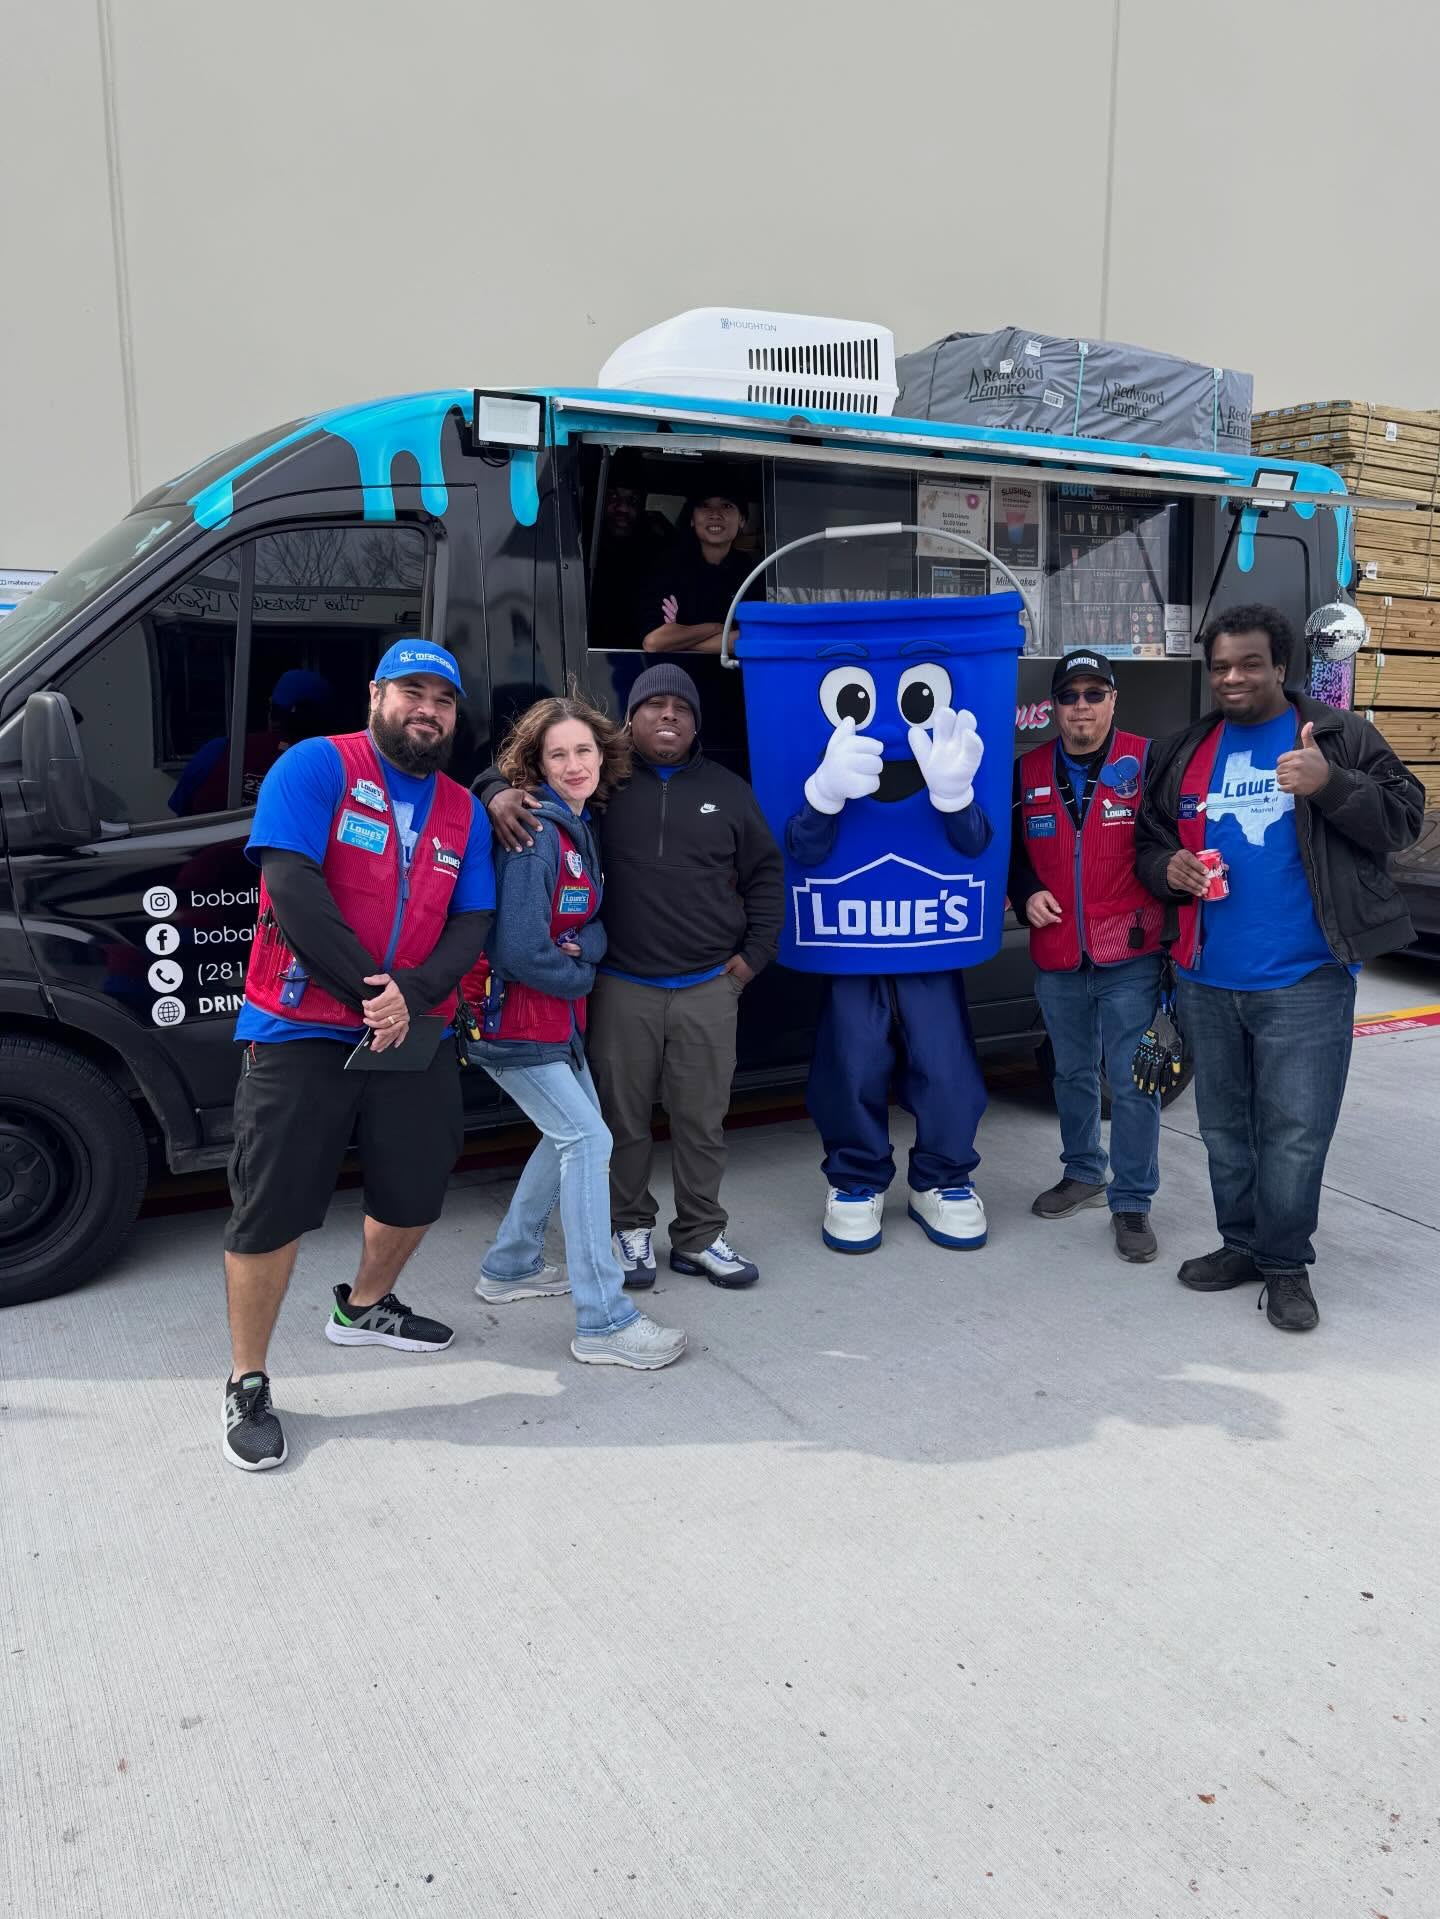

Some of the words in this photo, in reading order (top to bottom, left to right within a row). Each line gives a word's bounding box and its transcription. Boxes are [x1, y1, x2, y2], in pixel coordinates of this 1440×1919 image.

[729, 320, 777, 332] HOUGHTON
[980, 382, 1026, 400] Empire
[1114, 382, 1164, 406] Redwood
[1112, 397, 1149, 418] Empire
[1228, 405, 1252, 421] Red
[1001, 488, 1032, 498] SLUSHIES
[1105, 808, 1132, 818] LOWE'S
[350, 823, 382, 840] LOWE'S
[191, 887, 259, 907] bobali
[565, 894, 586, 902] LOWE'S
[811, 889, 969, 936] LOWE'S
